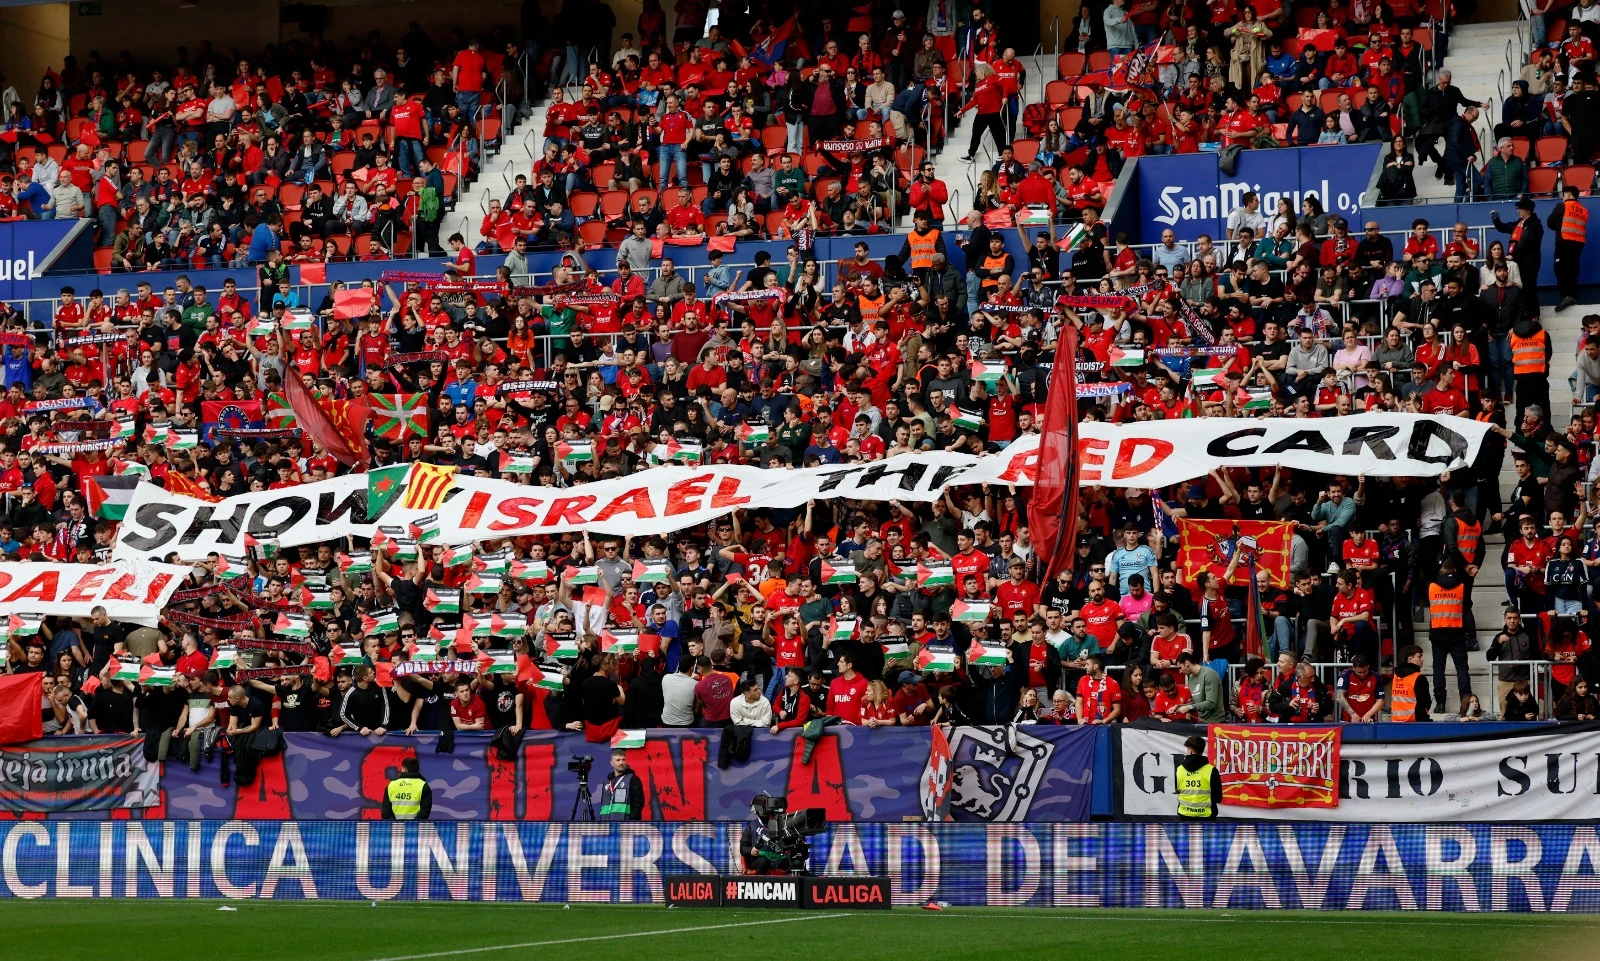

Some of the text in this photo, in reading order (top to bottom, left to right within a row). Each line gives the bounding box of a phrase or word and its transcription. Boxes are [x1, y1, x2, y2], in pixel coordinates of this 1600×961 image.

[824, 138, 882, 151] AUPA OSASUNA
[1153, 186, 1215, 226] San
[1065, 295, 1122, 305] OSASUNA
[1193, 318, 1214, 344] OSASUNA
[37, 398, 86, 409] OSASUNA
[121, 484, 409, 552] SHOW
[459, 473, 751, 531] ISRAEL
[997, 437, 1174, 482] RED
[1206, 420, 1468, 464] CARD
[748, 563, 769, 586] 34
[834, 694, 851, 702] #Life
[56, 749, 132, 783] iruña
[1215, 737, 1333, 782] ERRIBERRI
[1186, 779, 1202, 788] 303
[1497, 752, 1600, 798] SU
[396, 792, 412, 800] 405
[2, 820, 318, 899] CLINICA
[986, 822, 1100, 908] DE
[1144, 823, 1600, 912] NAVARRA
[670, 882, 714, 900] LALIGA
[726, 881, 797, 901] #FANCAM
[812, 884, 884, 904] LALIGA
